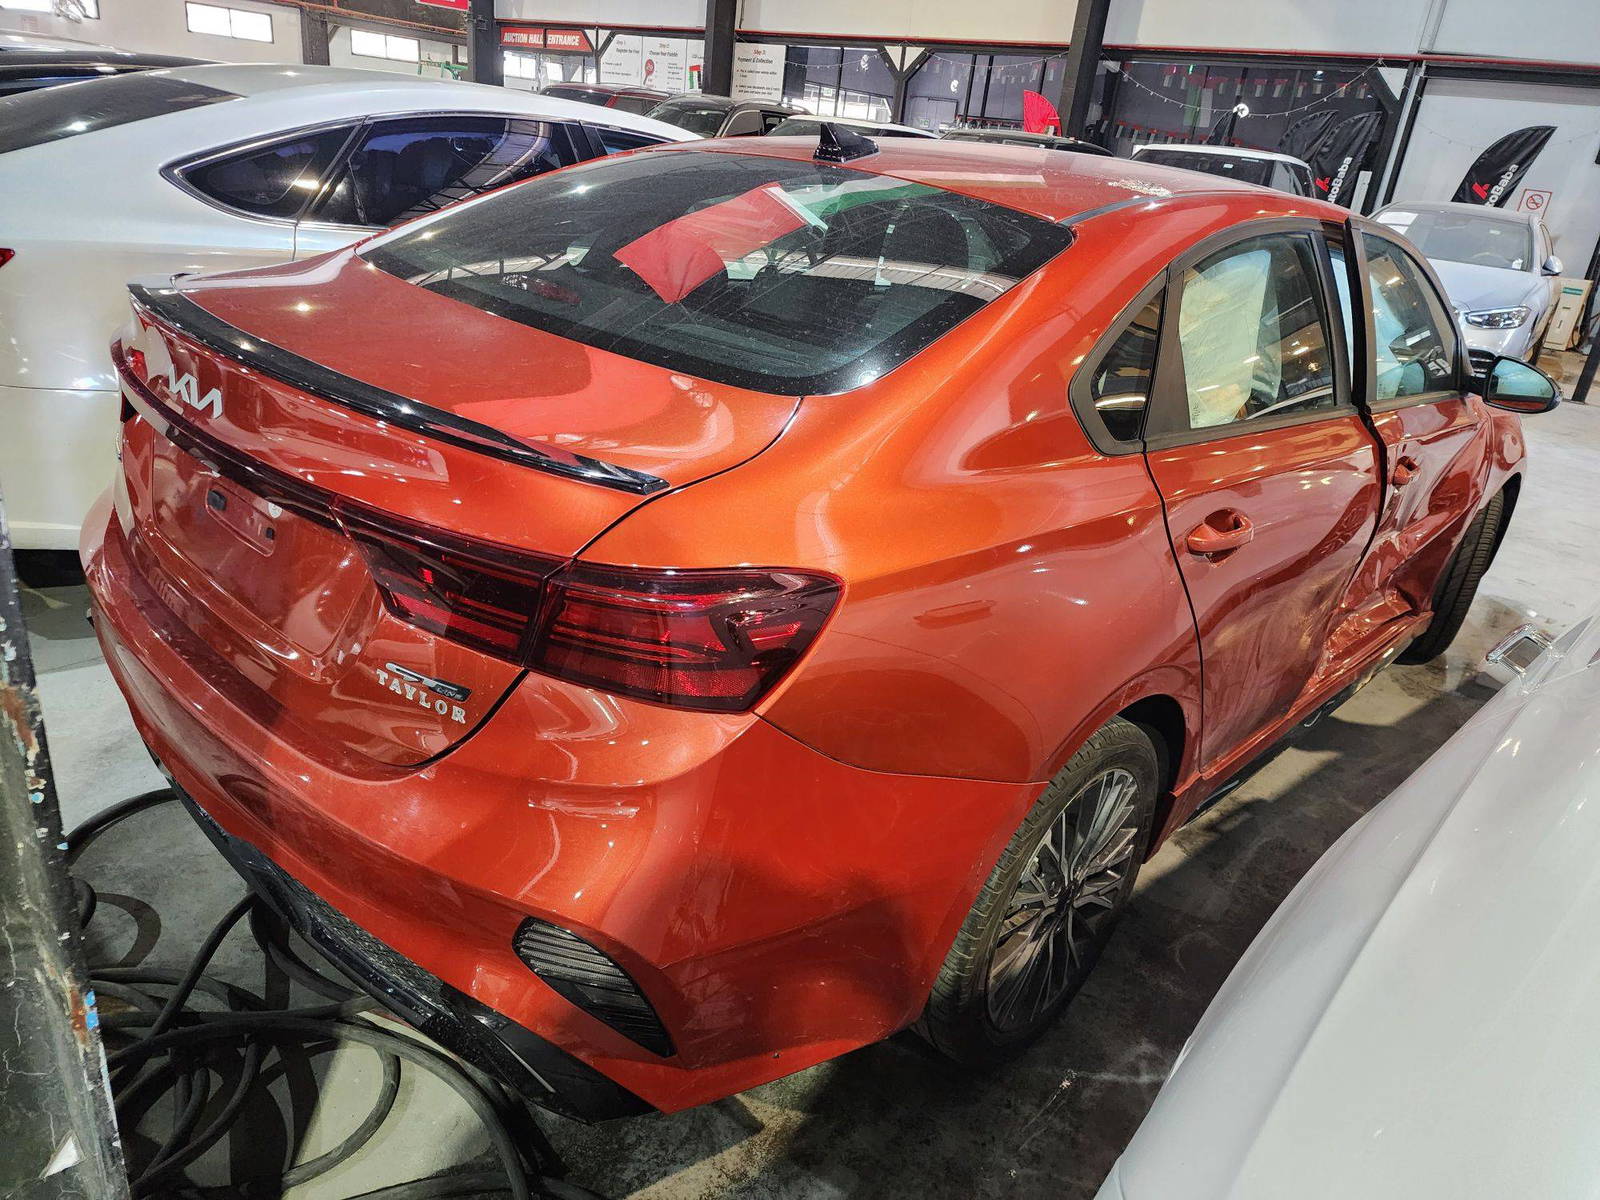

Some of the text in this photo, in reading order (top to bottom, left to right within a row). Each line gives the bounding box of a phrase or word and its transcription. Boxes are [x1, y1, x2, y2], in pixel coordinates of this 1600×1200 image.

[503, 32, 580, 46] AUCTION HALL ENTRANCE
[168, 363, 224, 419] KIA
[376, 668, 466, 724] TAYLOR
